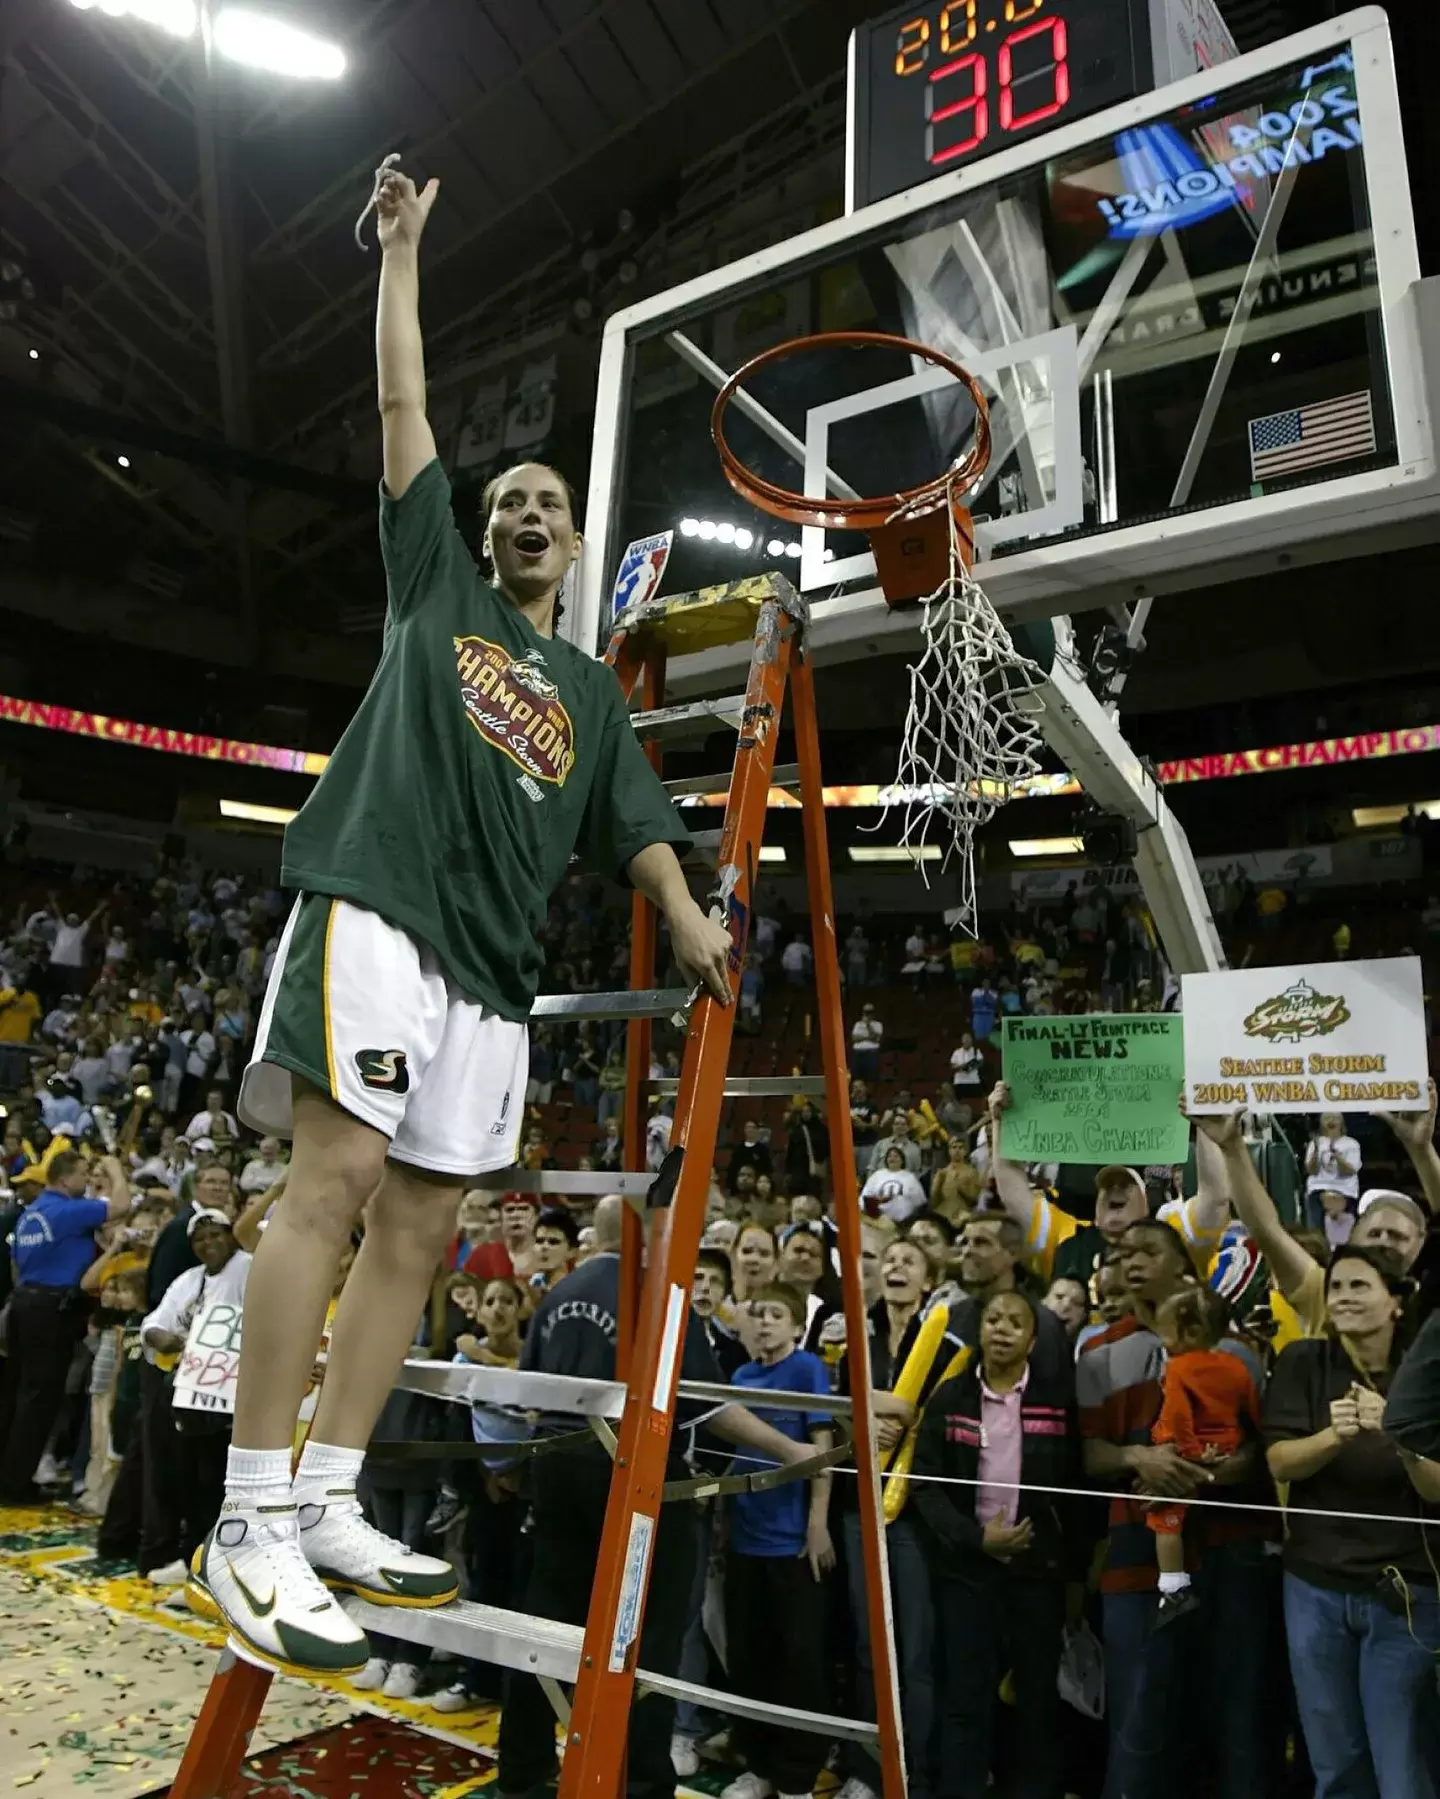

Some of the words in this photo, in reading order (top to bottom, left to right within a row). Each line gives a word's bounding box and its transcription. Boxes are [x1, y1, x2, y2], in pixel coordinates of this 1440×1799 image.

[929, 16, 1070, 165] 30
[630, 537, 668, 556] WNBA
[0, 694, 97, 734] WNBA
[1158, 753, 1250, 783] WNBA
[1257, 725, 1440, 770] CHAMPIO
[1246, 997, 1344, 1036] STORM
[1050, 1038, 1129, 1060] NEWS
[1220, 1056, 1304, 1078] SEATTLE
[1308, 1053, 1387, 1075] STORM
[1193, 1083, 1248, 1105] 2004
[1252, 1080, 1320, 1102] WNBA
[1323, 1078, 1421, 1101] CHAMPS
[1007, 1120, 1080, 1154] WNBA
